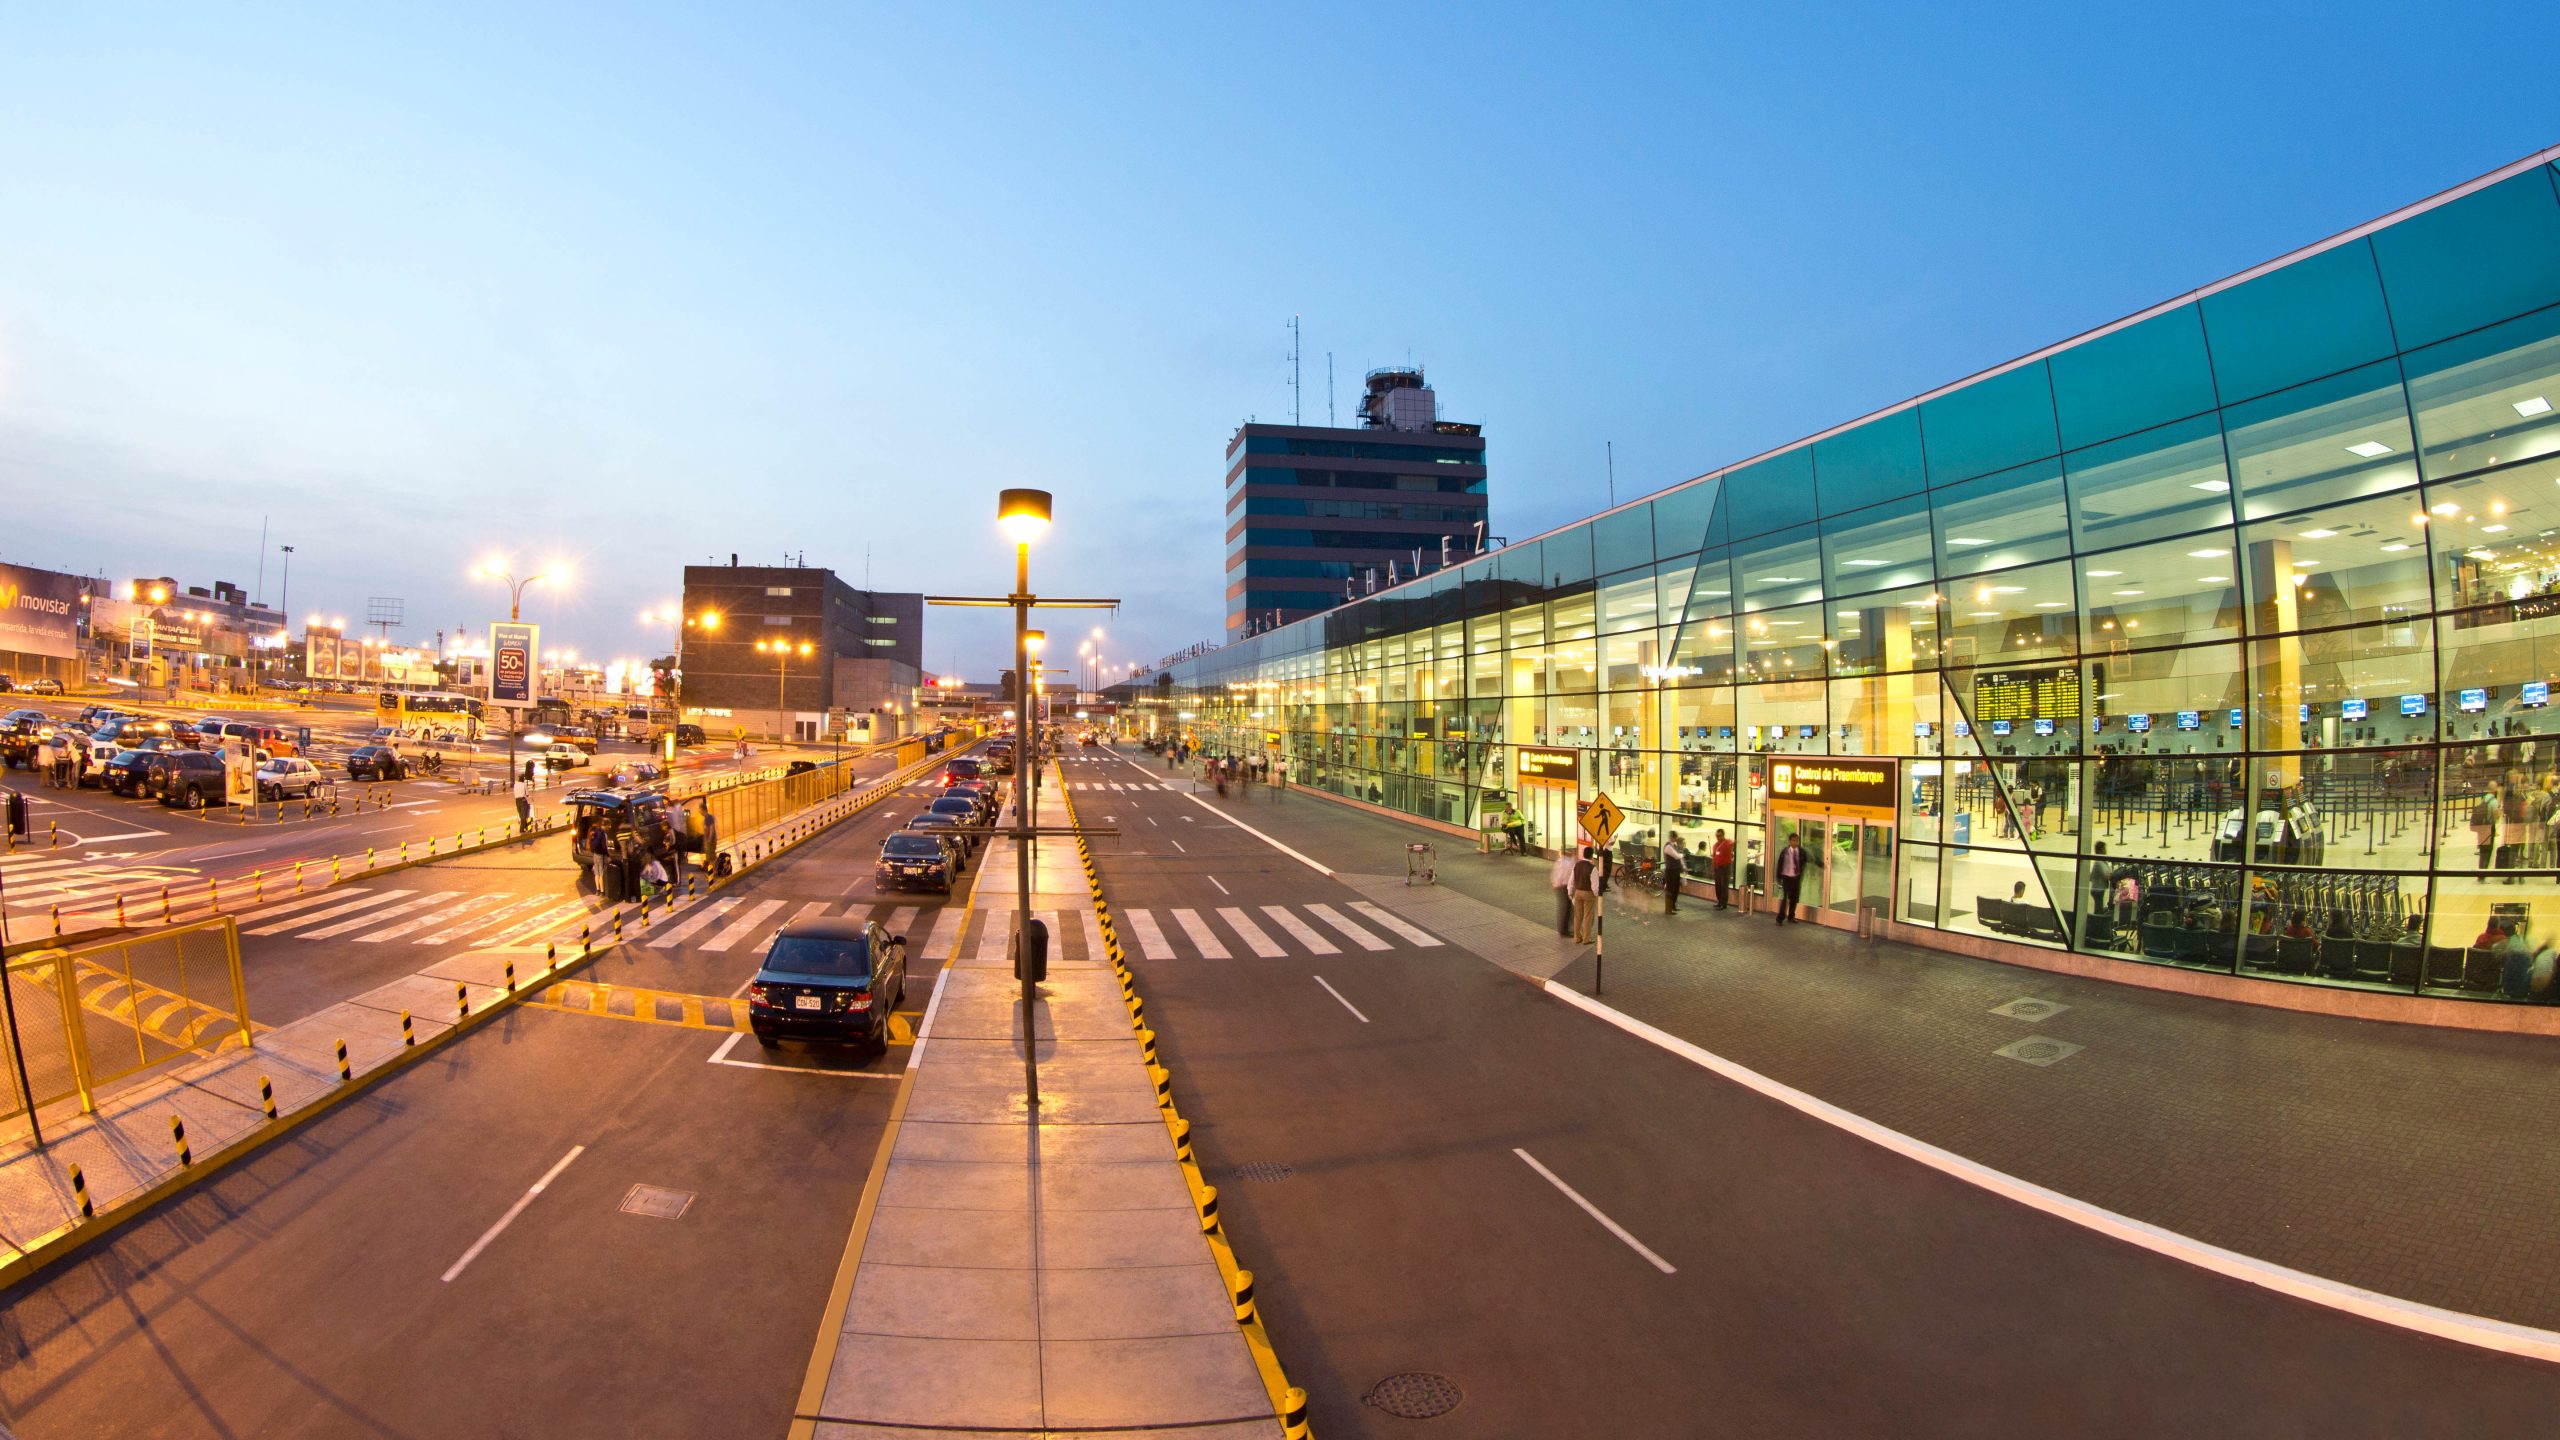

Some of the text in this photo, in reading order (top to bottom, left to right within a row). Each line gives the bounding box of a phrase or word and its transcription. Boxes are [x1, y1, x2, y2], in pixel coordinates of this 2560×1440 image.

[1346, 519, 1485, 601] CHAVEZ
[20, 594, 71, 616] movistar
[501, 656, 523, 670] 50%
[2487, 686, 2497, 699] 51
[1549, 754, 1572, 766] Preembarque
[1795, 766, 1884, 785] Control de Preembarque
[1795, 782, 1813, 795] Check
